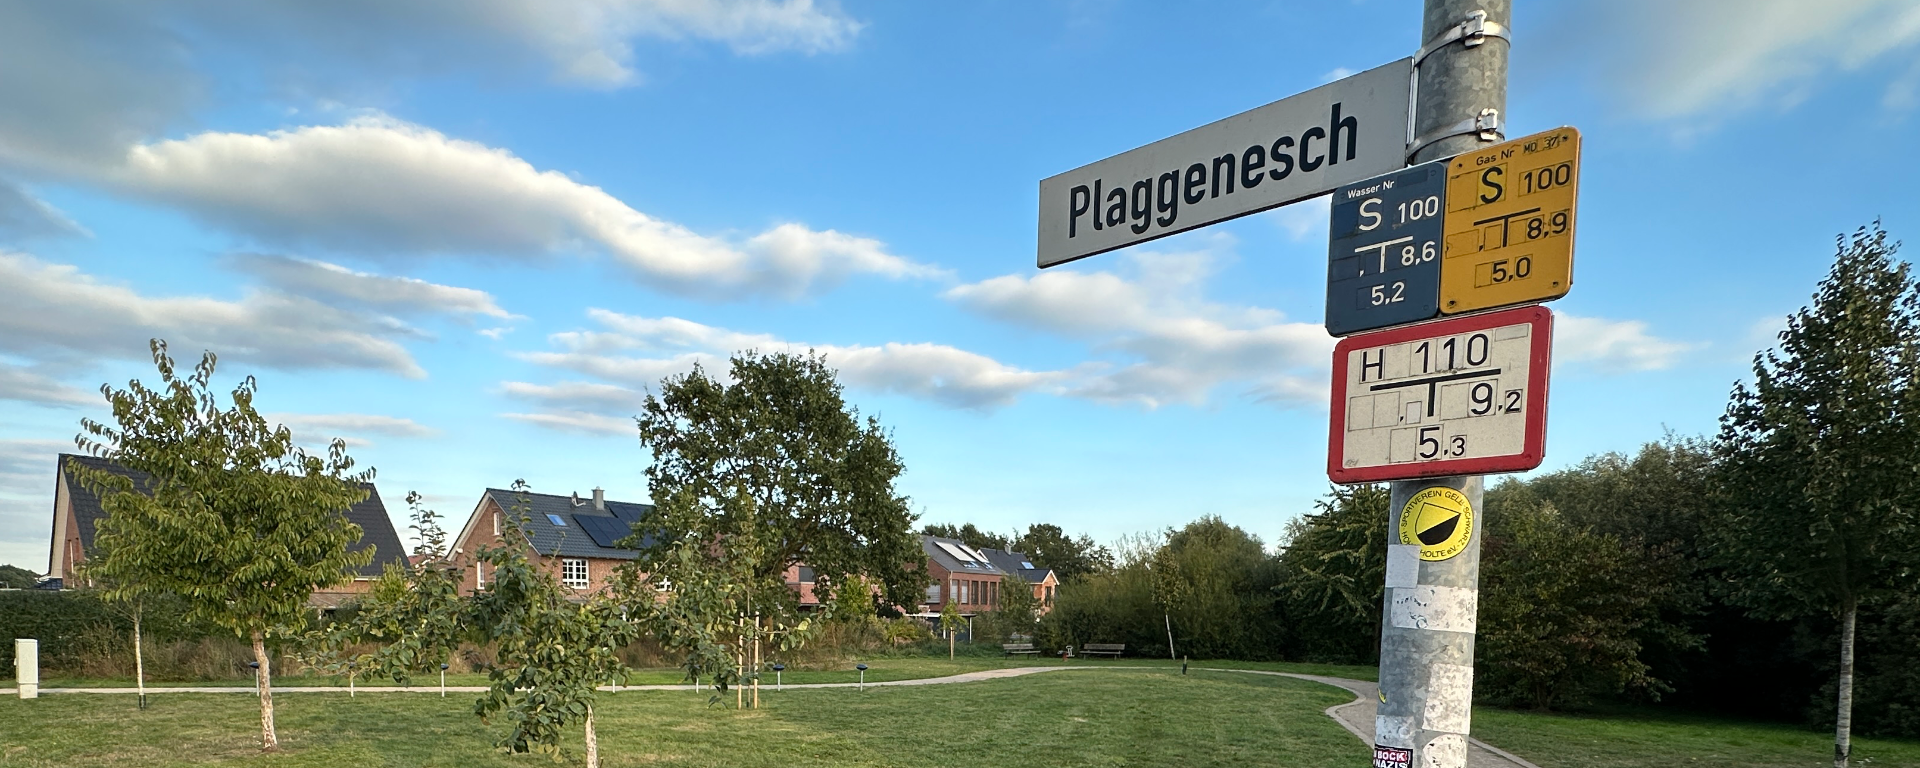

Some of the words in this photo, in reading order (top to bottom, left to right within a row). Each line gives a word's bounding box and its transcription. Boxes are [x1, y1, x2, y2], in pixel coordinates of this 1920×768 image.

[1069, 102, 1358, 238] Plaggenesch
[1476, 155, 1497, 166] Gas
[1501, 148, 1514, 159] Nr
[1347, 184, 1381, 199] Wasser
[1382, 179, 1395, 191] Nr
[1480, 166, 1503, 204] S
[1524, 163, 1571, 194] 100
[1358, 197, 1383, 231] S
[1398, 195, 1439, 224] 100
[1492, 256, 1531, 283] 5,0
[1371, 281, 1406, 306] 5,2
[1361, 348, 1384, 382] H
[1414, 333, 1489, 373] 110
[1419, 426, 1466, 458] 5,3
[1401, 490, 1442, 528] SPORTVEREIN
[1375, 759, 1408, 768] NAZIS
[1377, 750, 1406, 762] BOCK
